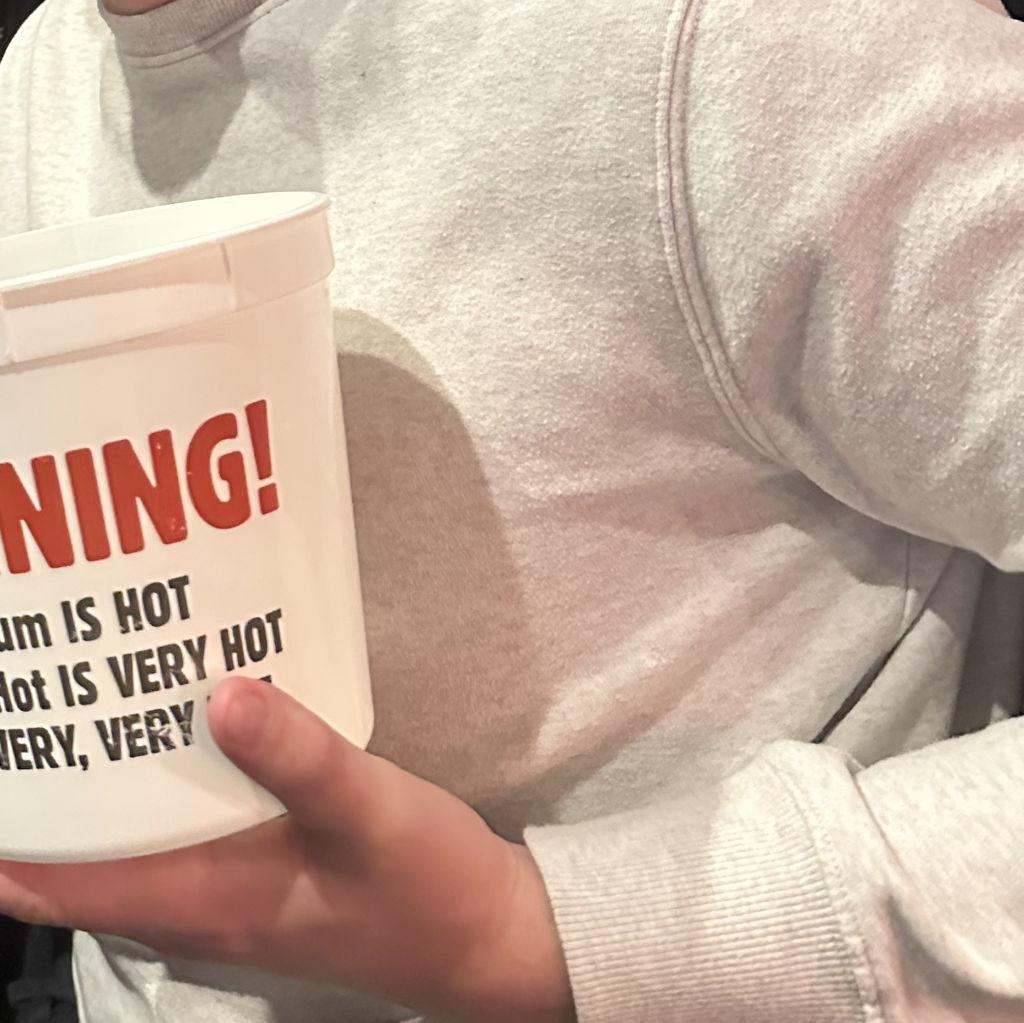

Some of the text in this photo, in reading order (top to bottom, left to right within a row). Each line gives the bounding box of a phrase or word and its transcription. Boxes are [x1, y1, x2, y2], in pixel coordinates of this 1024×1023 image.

[61, 597, 102, 643] IS
[113, 575, 192, 634] HOT
[58, 661, 98, 707] IS
[108, 634, 207, 697] VERY
[220, 608, 283, 672] HOT
[96, 700, 194, 761] VERY
